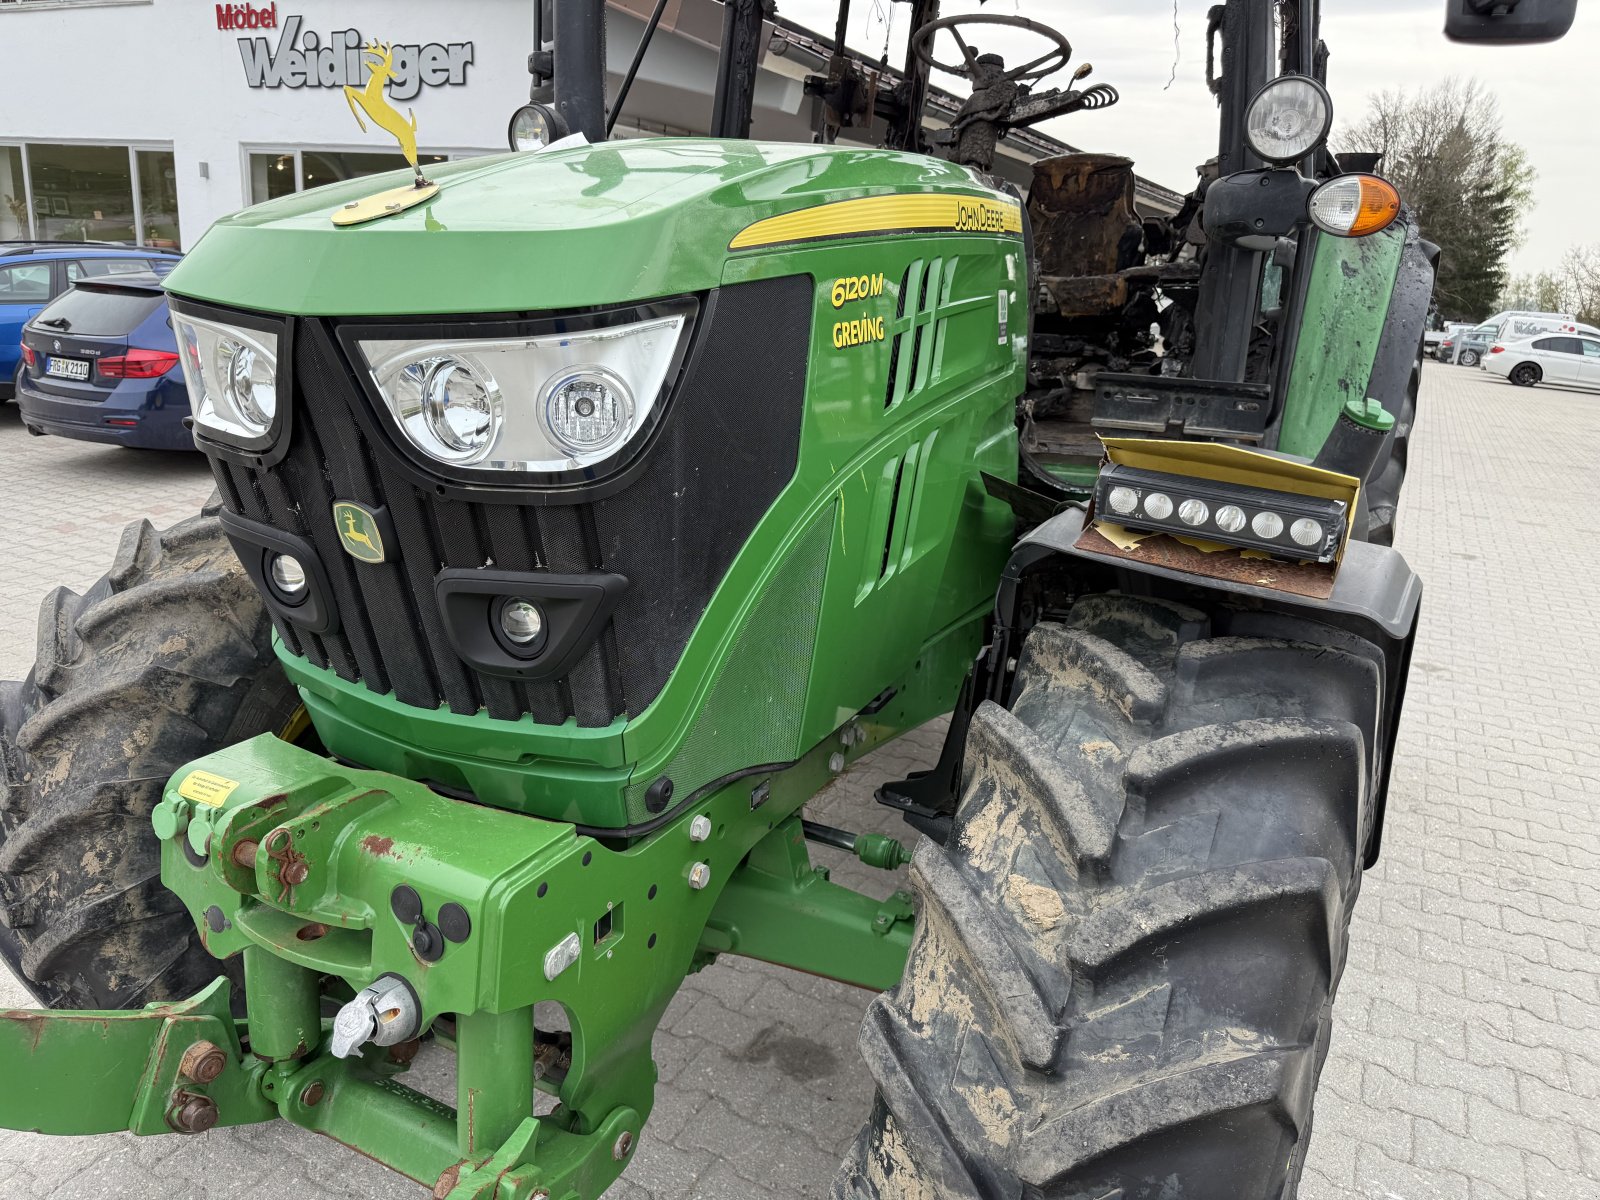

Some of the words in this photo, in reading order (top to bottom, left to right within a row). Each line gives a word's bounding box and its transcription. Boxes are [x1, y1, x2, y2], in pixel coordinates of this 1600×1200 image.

[216, 2, 277, 30] Möbel
[50, 359, 61, 372] FRG
[65, 361, 70, 373] K
[70, 362, 88, 376] 2110
